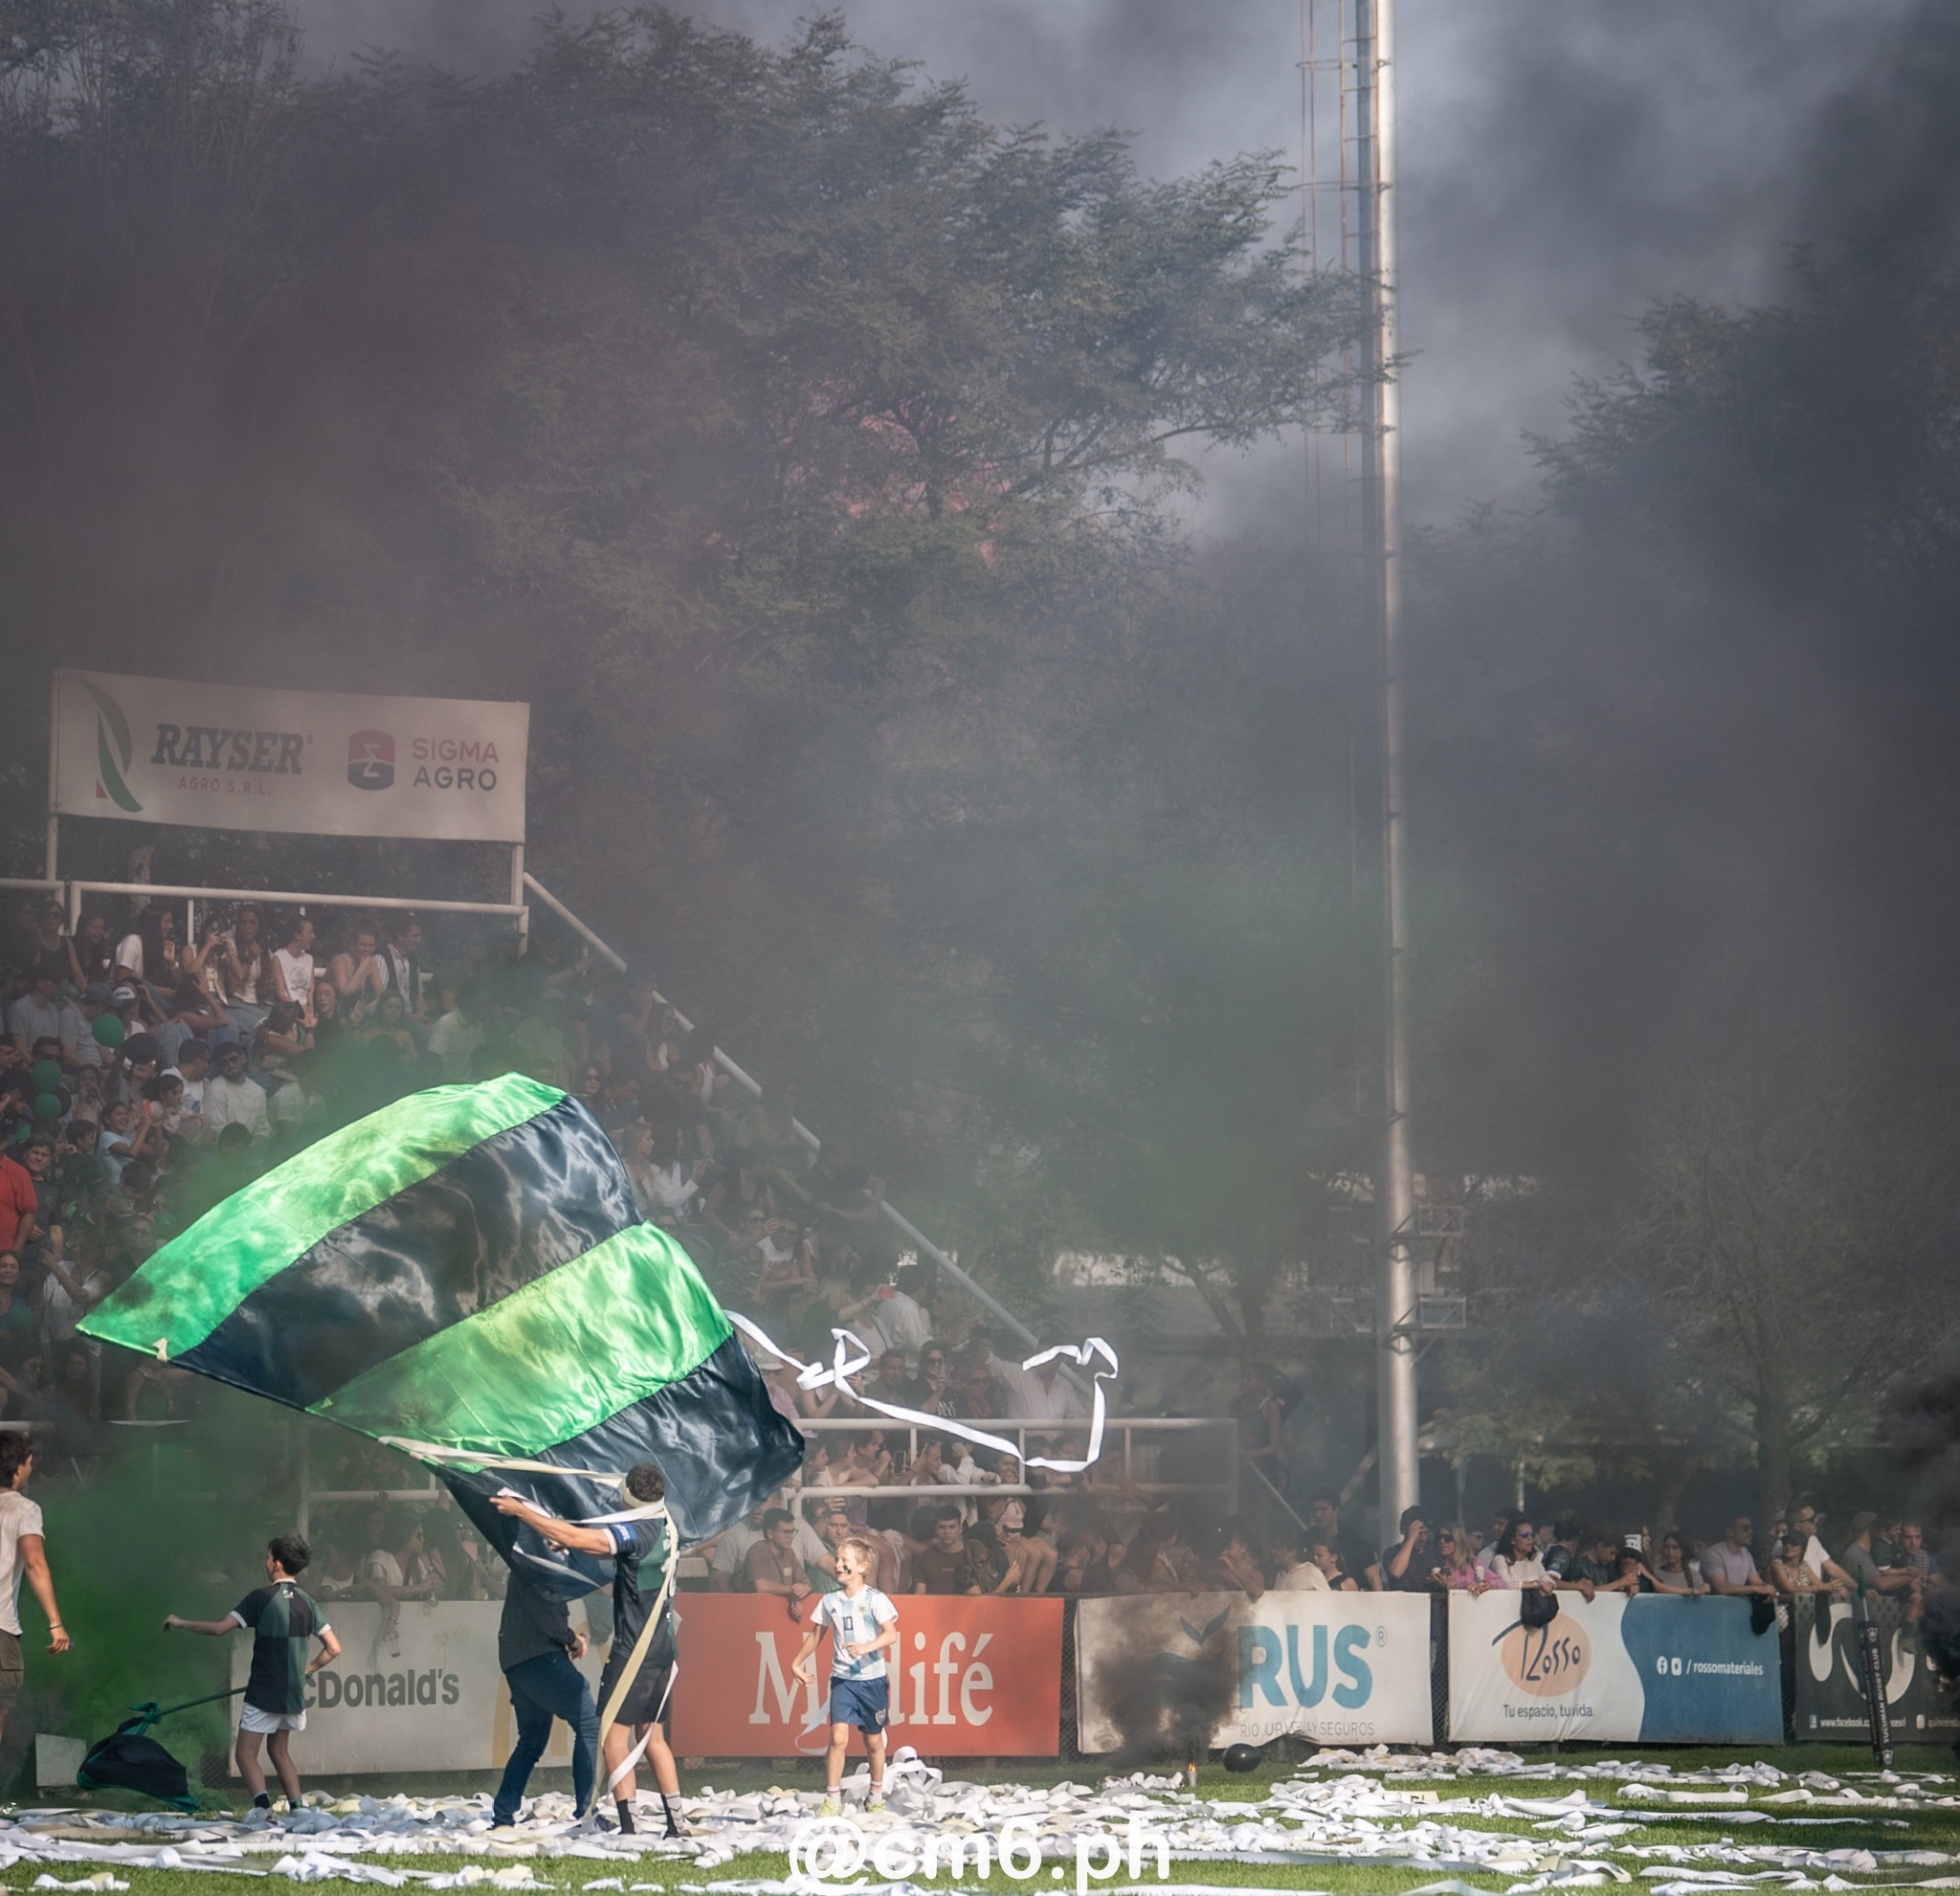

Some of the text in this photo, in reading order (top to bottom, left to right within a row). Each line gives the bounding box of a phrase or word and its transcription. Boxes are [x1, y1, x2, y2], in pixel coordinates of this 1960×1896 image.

[150, 723, 304, 774] RAYSER
[412, 737, 500, 764] SIGMA
[178, 775, 272, 796] AGRO S.R.L.
[412, 766, 498, 792] AGRO
[1693, 1661, 1764, 1676] rossomateriales
[1871, 1647, 1881, 1670] CLUB
[303, 1668, 460, 1708] cDonald's
[748, 1627, 993, 1727] Mdifé
[1503, 1704, 1515, 1718] Tu
[1517, 1704, 1557, 1721] espacio,
[1239, 1724, 1260, 1738] RIO
[1320, 1722, 1375, 1737] SEGUROS
